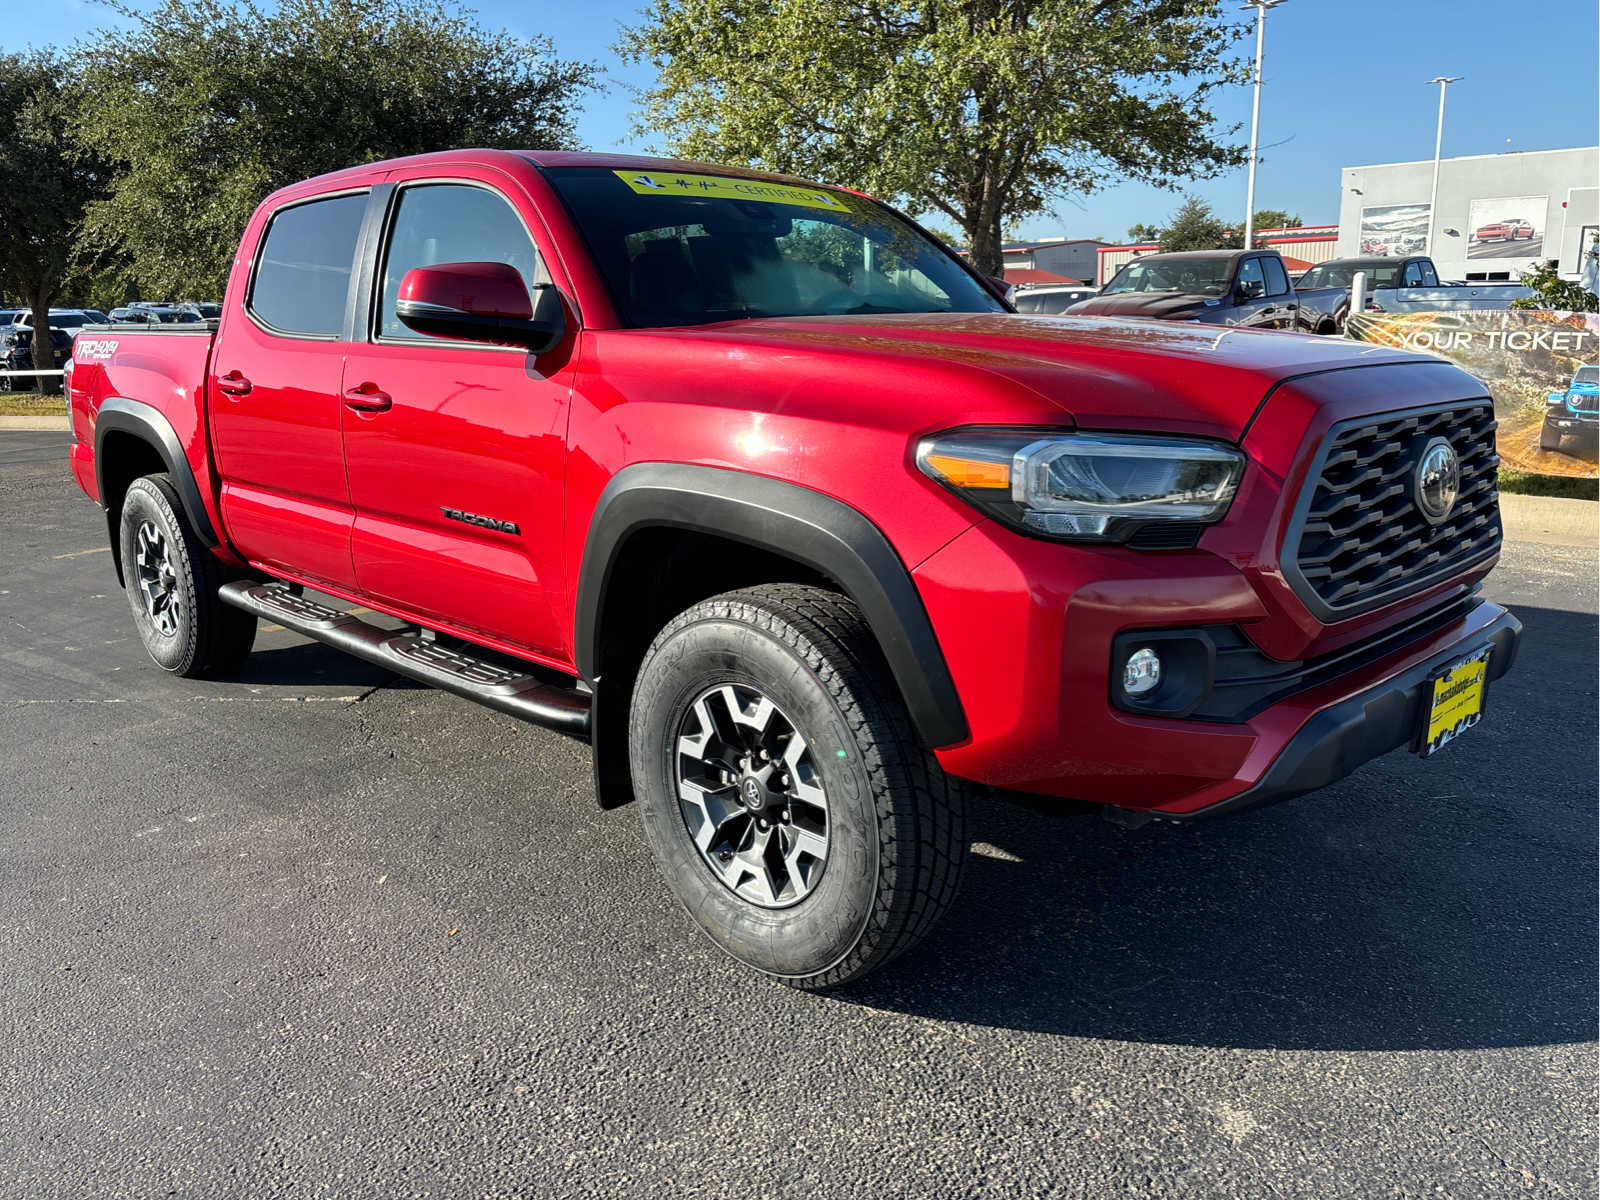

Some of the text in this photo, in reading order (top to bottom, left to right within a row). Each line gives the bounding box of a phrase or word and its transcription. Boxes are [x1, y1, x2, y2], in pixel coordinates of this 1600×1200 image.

[734, 183, 813, 201] CERTIFIED
[1399, 331, 1591, 351] YOUR TICKET
[439, 505, 522, 536] TACOMA
